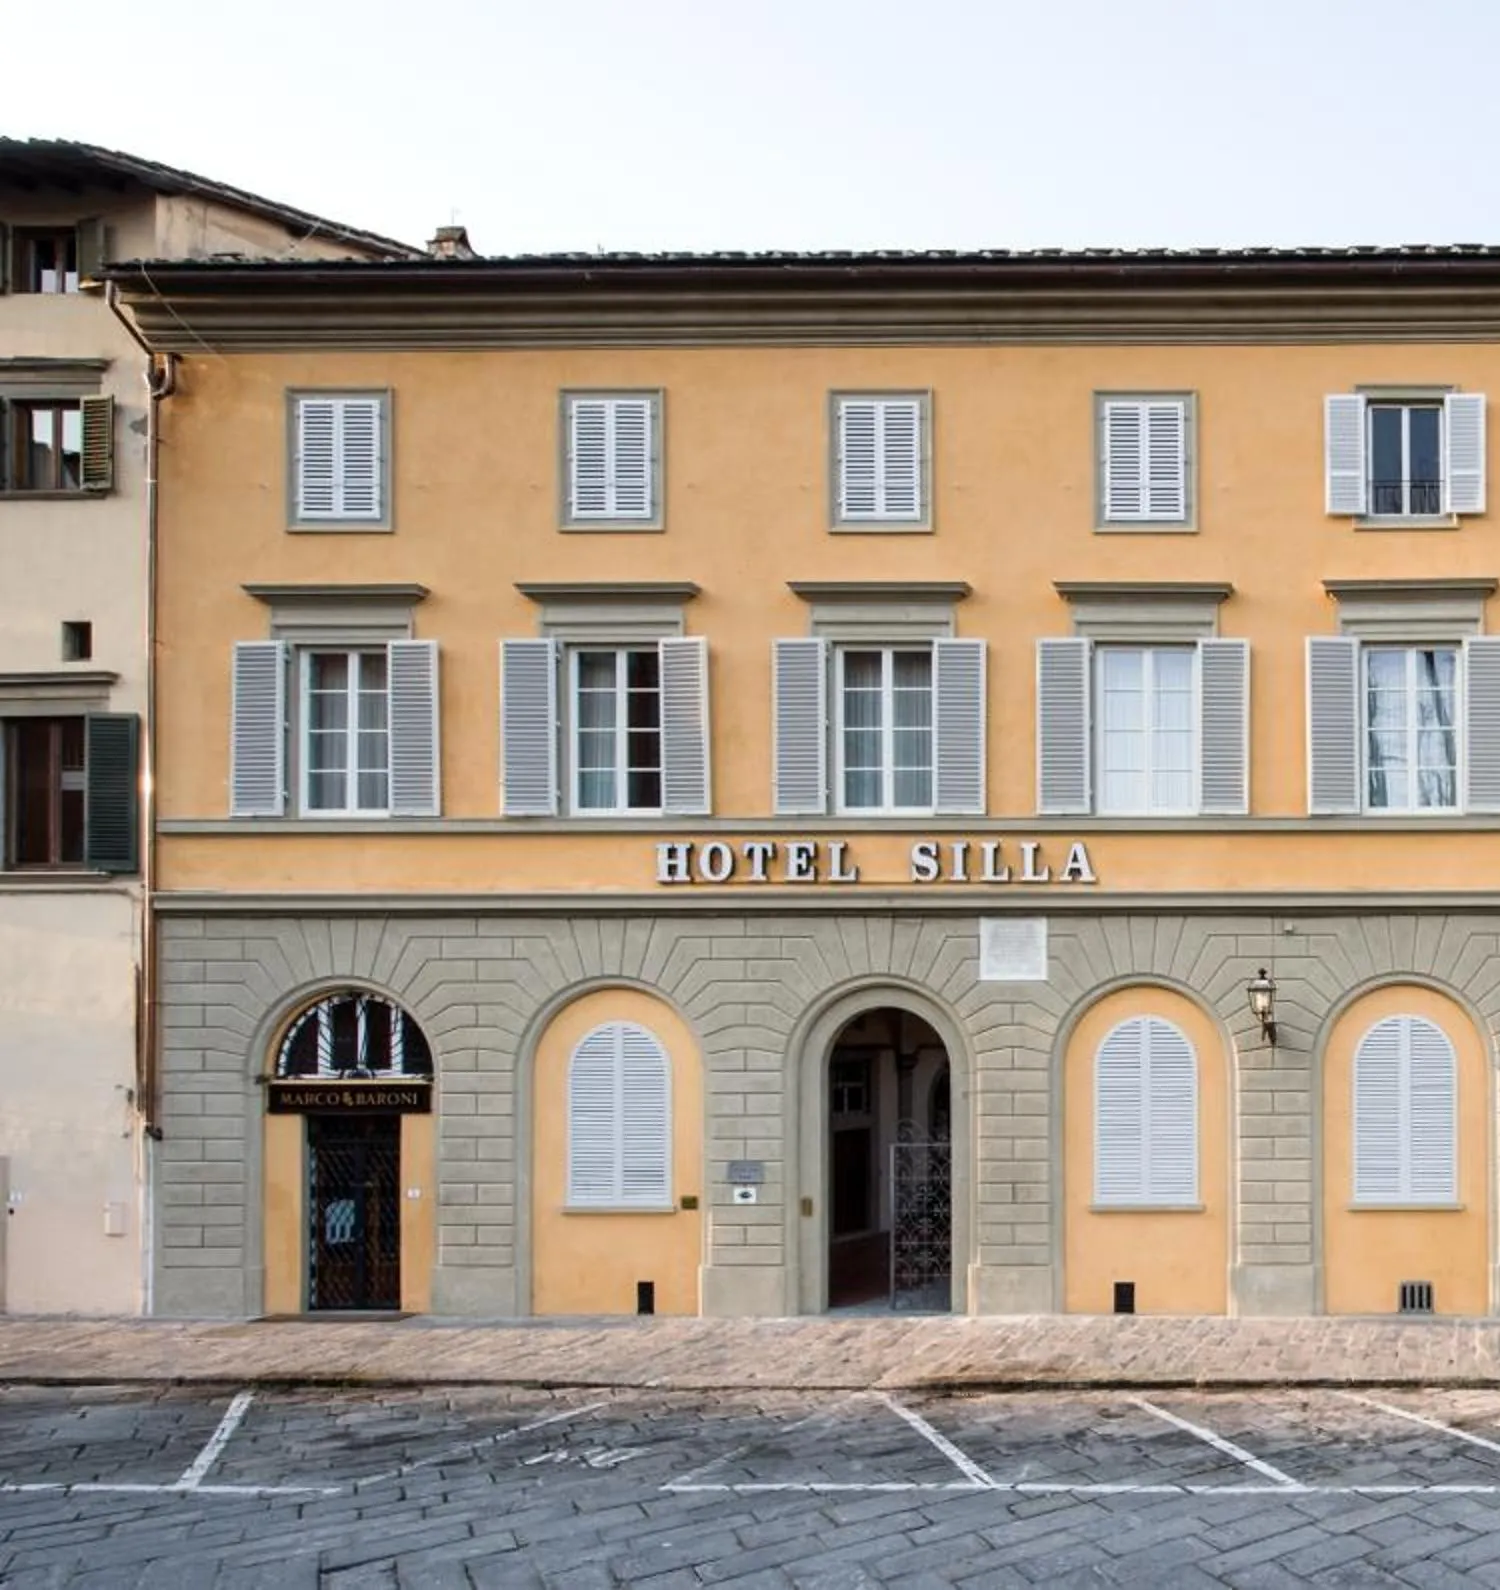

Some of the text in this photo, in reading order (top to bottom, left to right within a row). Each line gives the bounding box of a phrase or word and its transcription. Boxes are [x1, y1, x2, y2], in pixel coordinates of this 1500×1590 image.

[656, 841, 1097, 884] HOTEL SILLA
[281, 1091, 340, 1105] MARCO
[355, 1092, 418, 1105] BARONI
